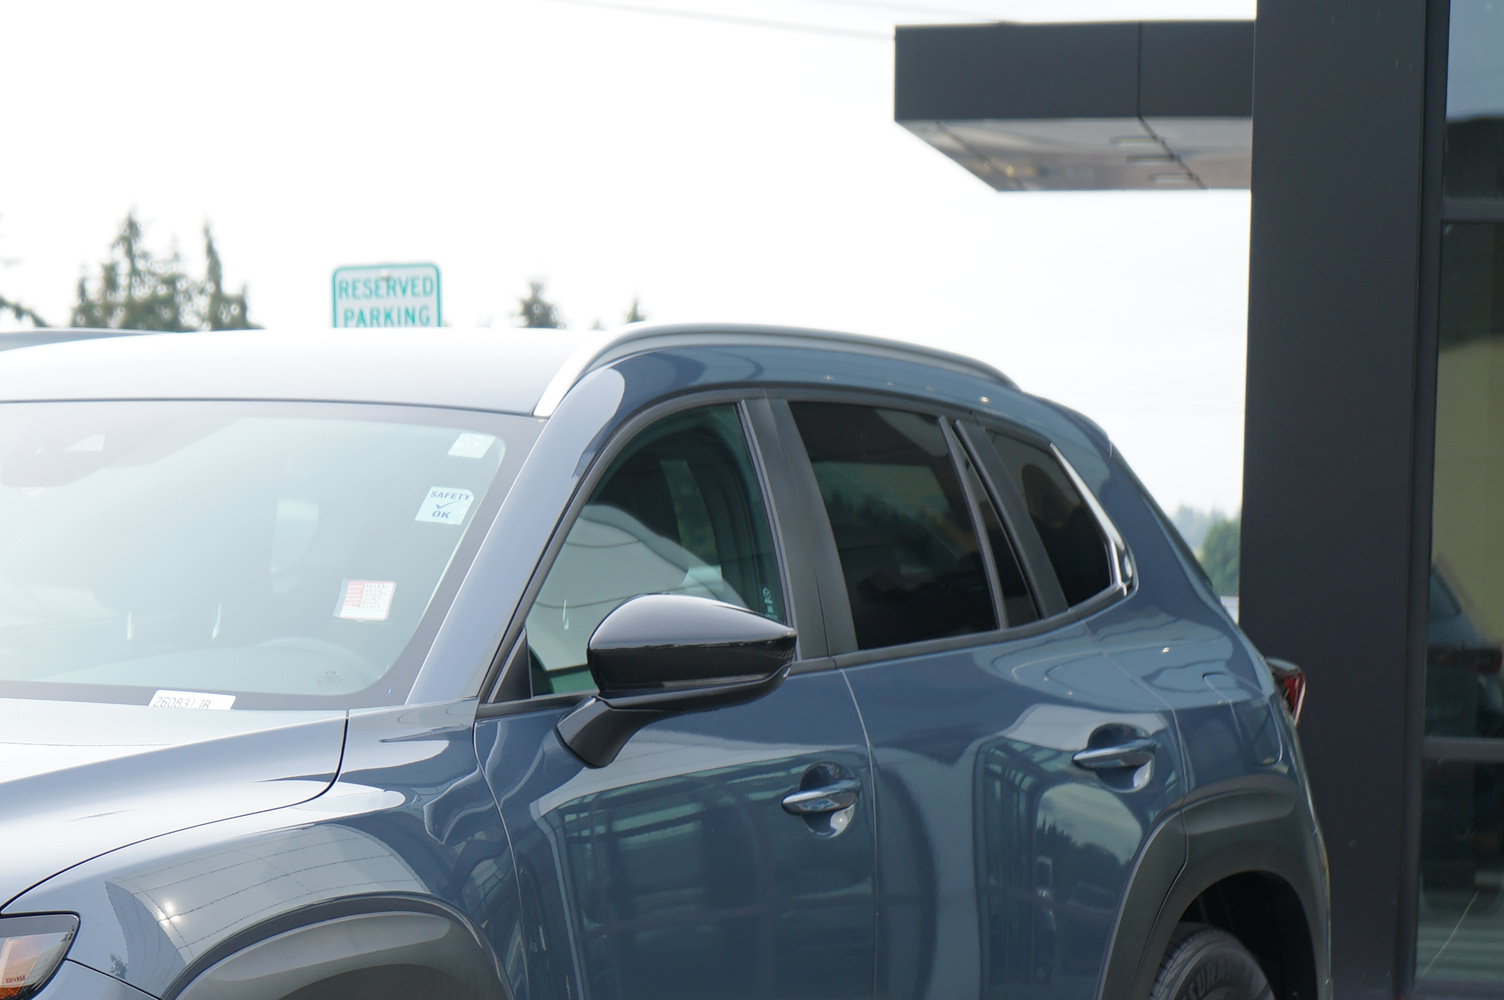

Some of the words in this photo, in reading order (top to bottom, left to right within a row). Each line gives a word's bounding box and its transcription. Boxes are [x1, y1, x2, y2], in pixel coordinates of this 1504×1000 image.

[338, 276, 434, 299] RESERVED
[344, 305, 430, 328] PARKING
[431, 491, 471, 500] SAFETY
